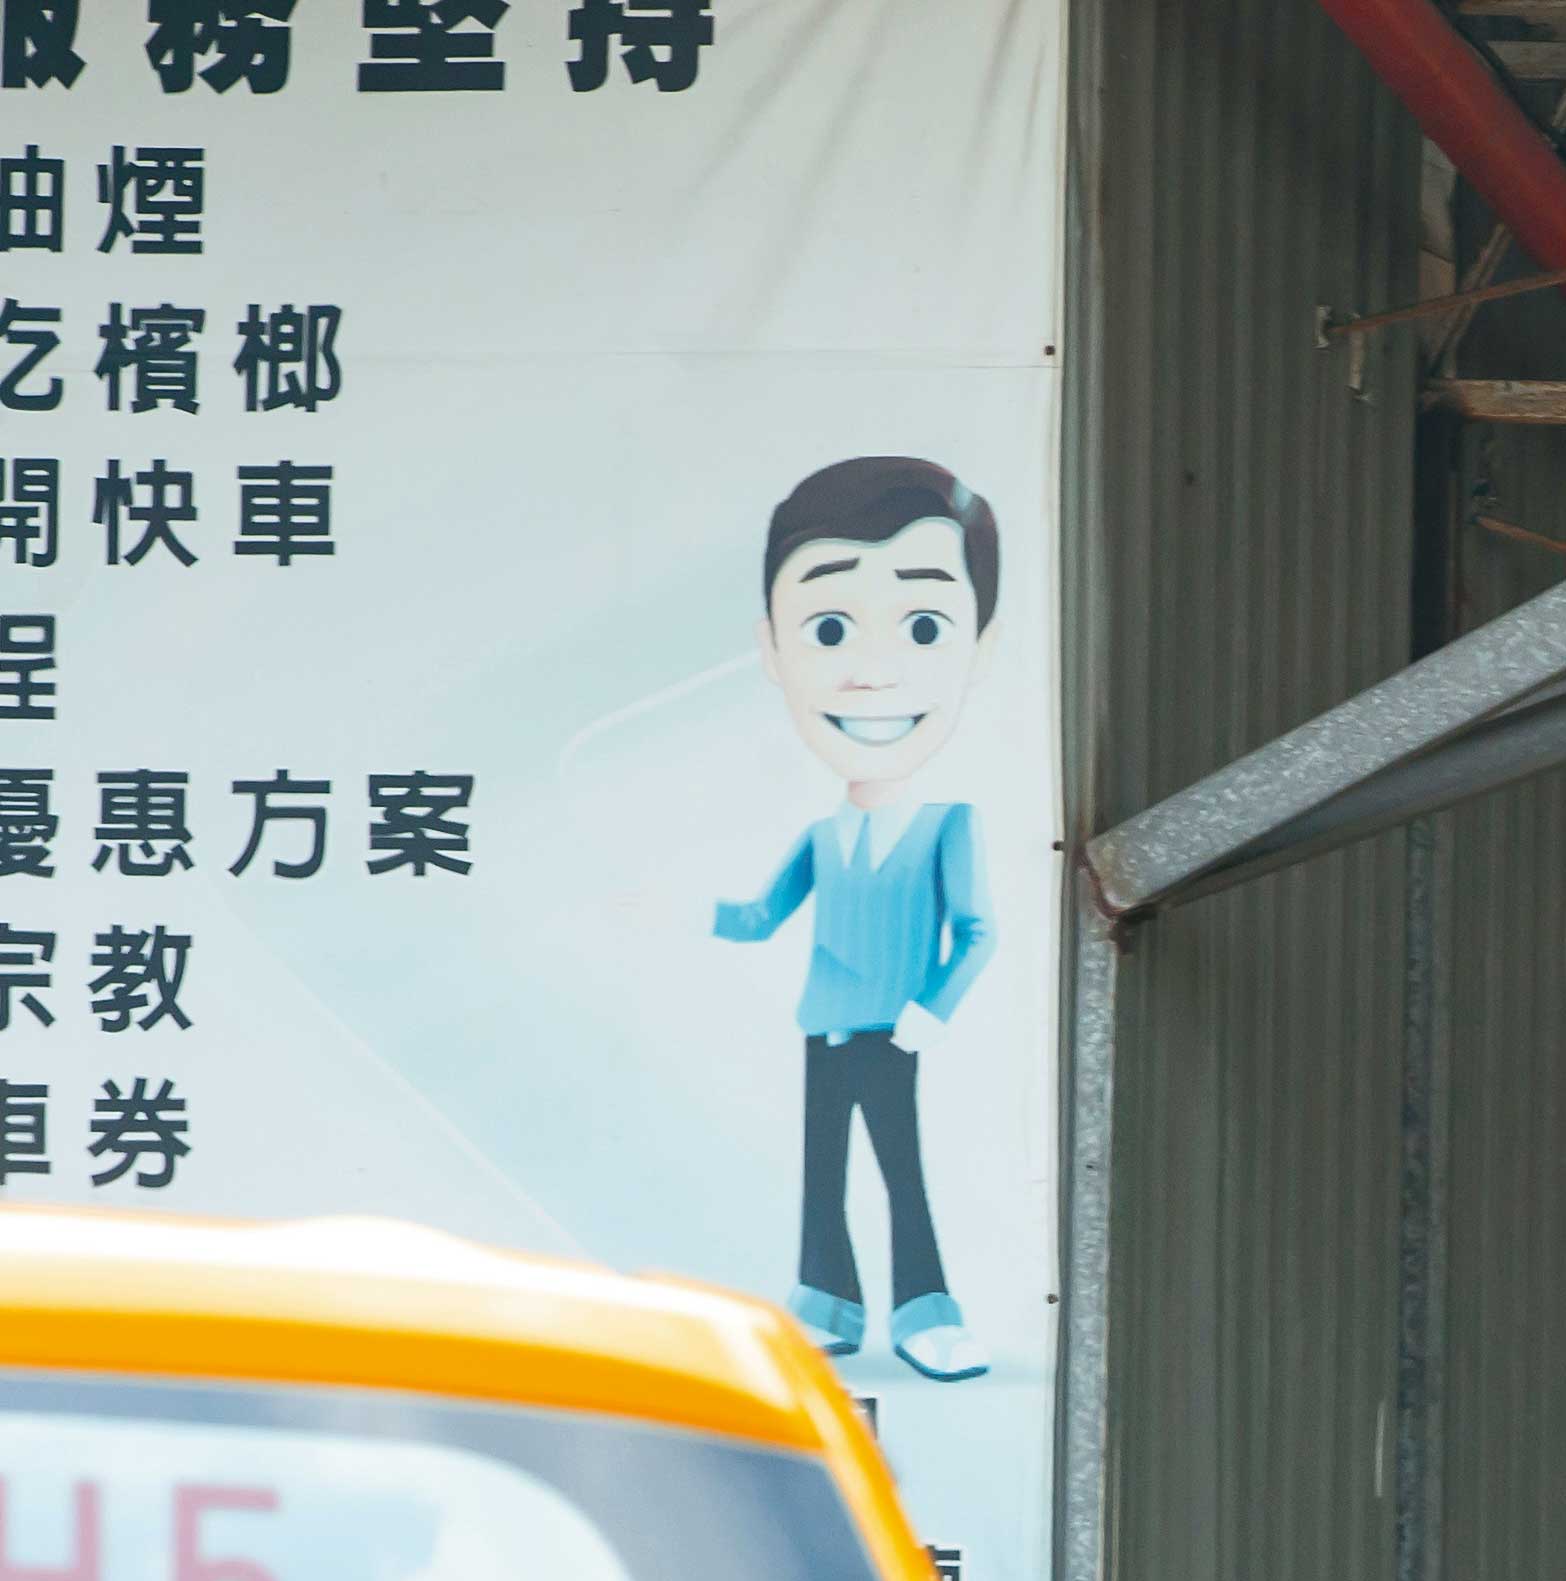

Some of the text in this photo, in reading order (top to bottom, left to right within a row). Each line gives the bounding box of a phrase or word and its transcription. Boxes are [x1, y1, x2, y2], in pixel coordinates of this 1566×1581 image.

[0, 458, 336, 568] 開快車
[0, 769, 475, 880] 優惠方案
